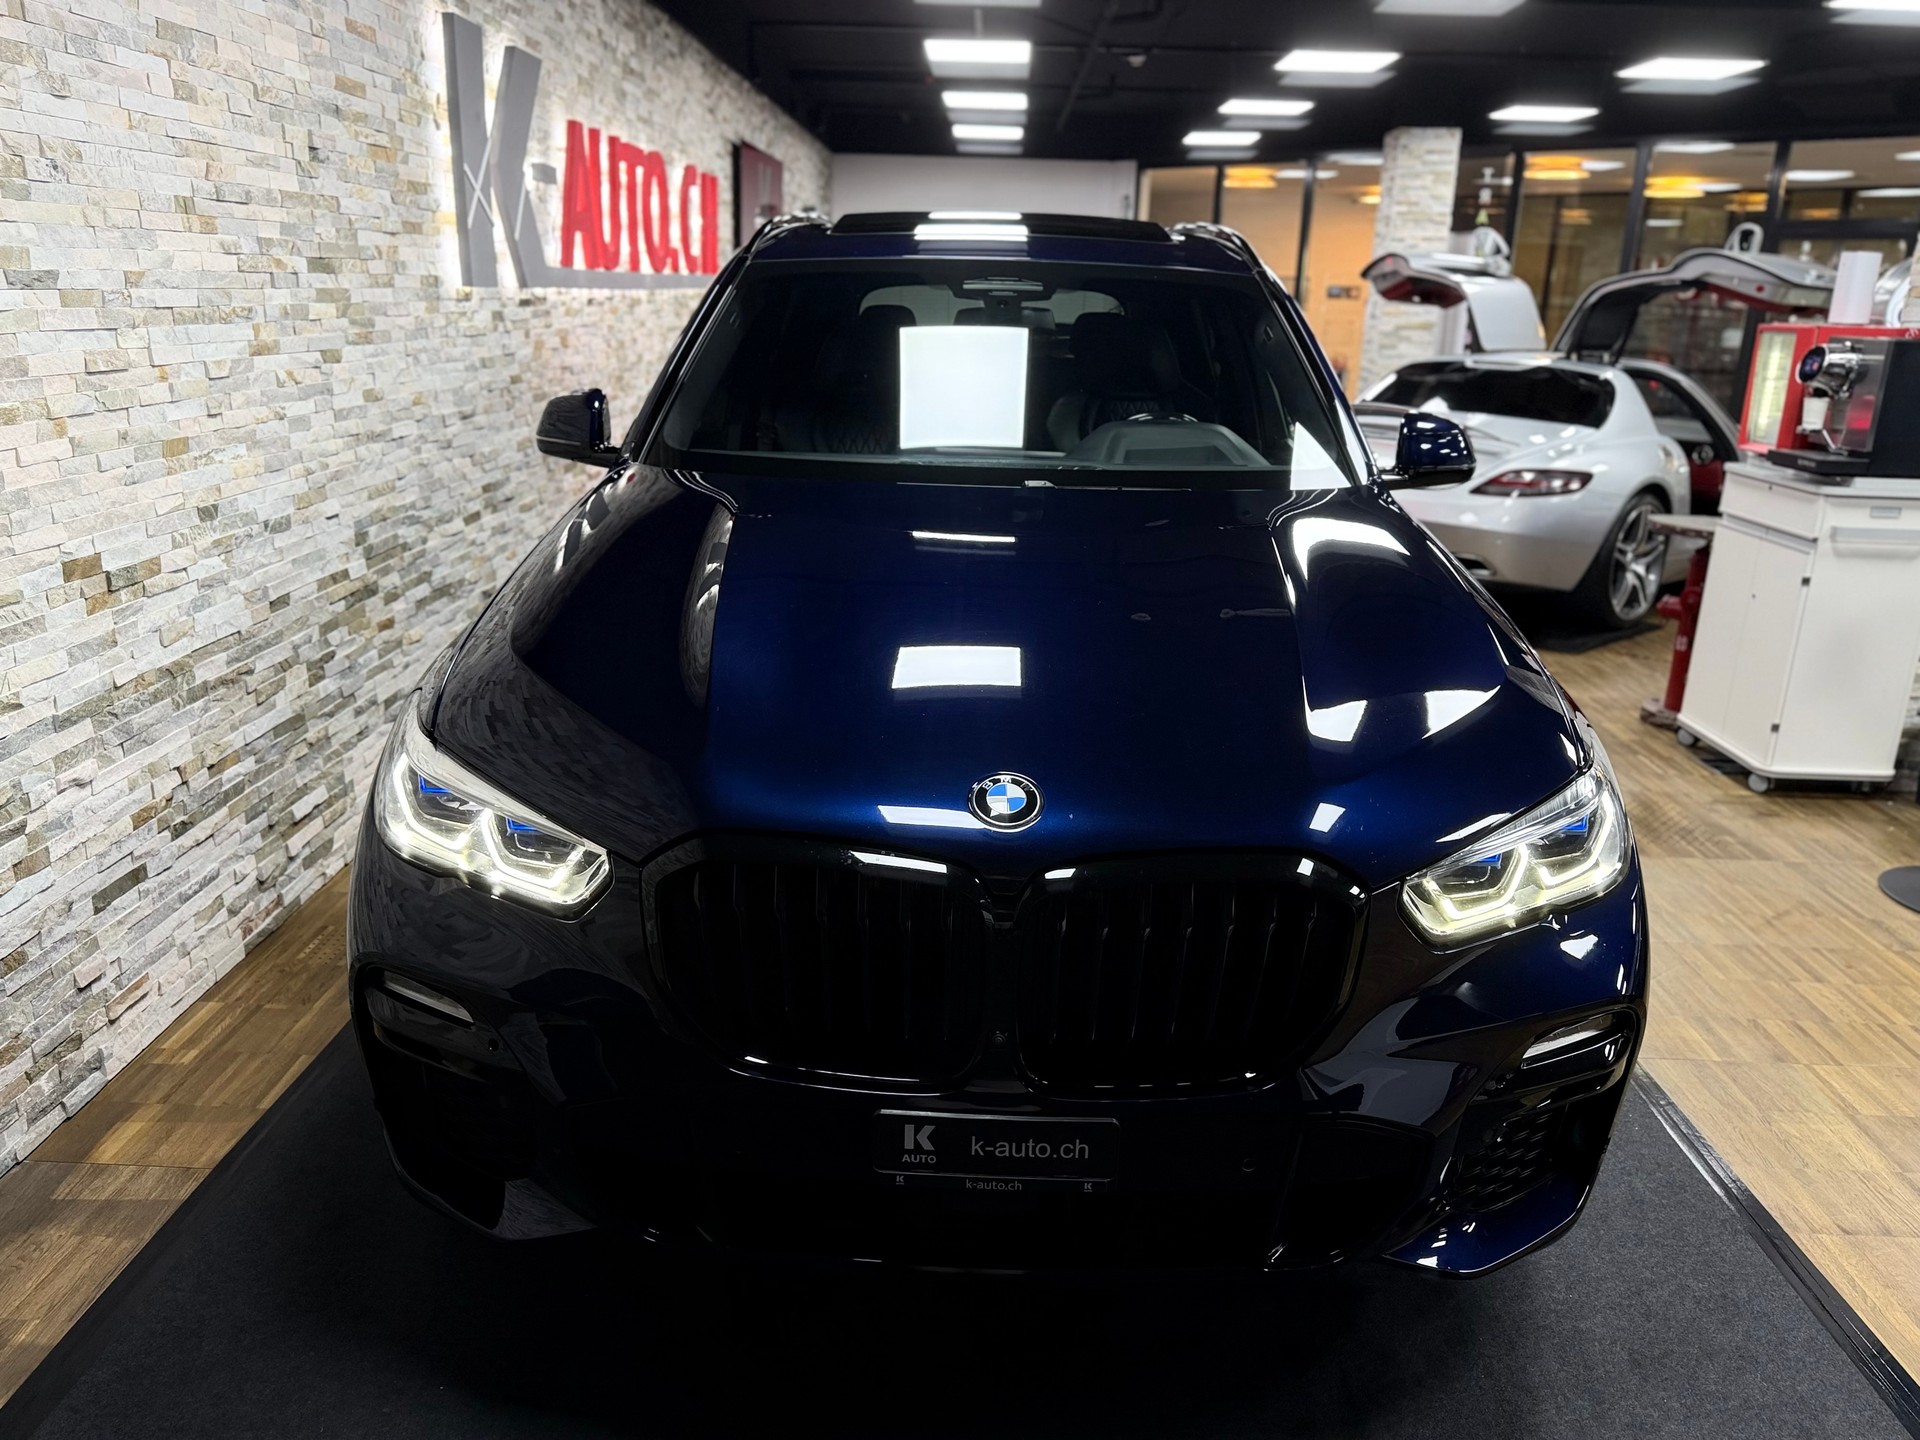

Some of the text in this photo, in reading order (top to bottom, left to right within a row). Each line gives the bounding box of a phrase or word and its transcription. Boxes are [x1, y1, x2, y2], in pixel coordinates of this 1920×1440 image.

[982, 776, 1034, 791] BMW
[904, 1124, 936, 1151] K
[971, 1136, 1089, 1159] k-auto.ch
[901, 1154, 937, 1164] AUTO
[966, 1179, 1022, 1191] k-auto.ch
